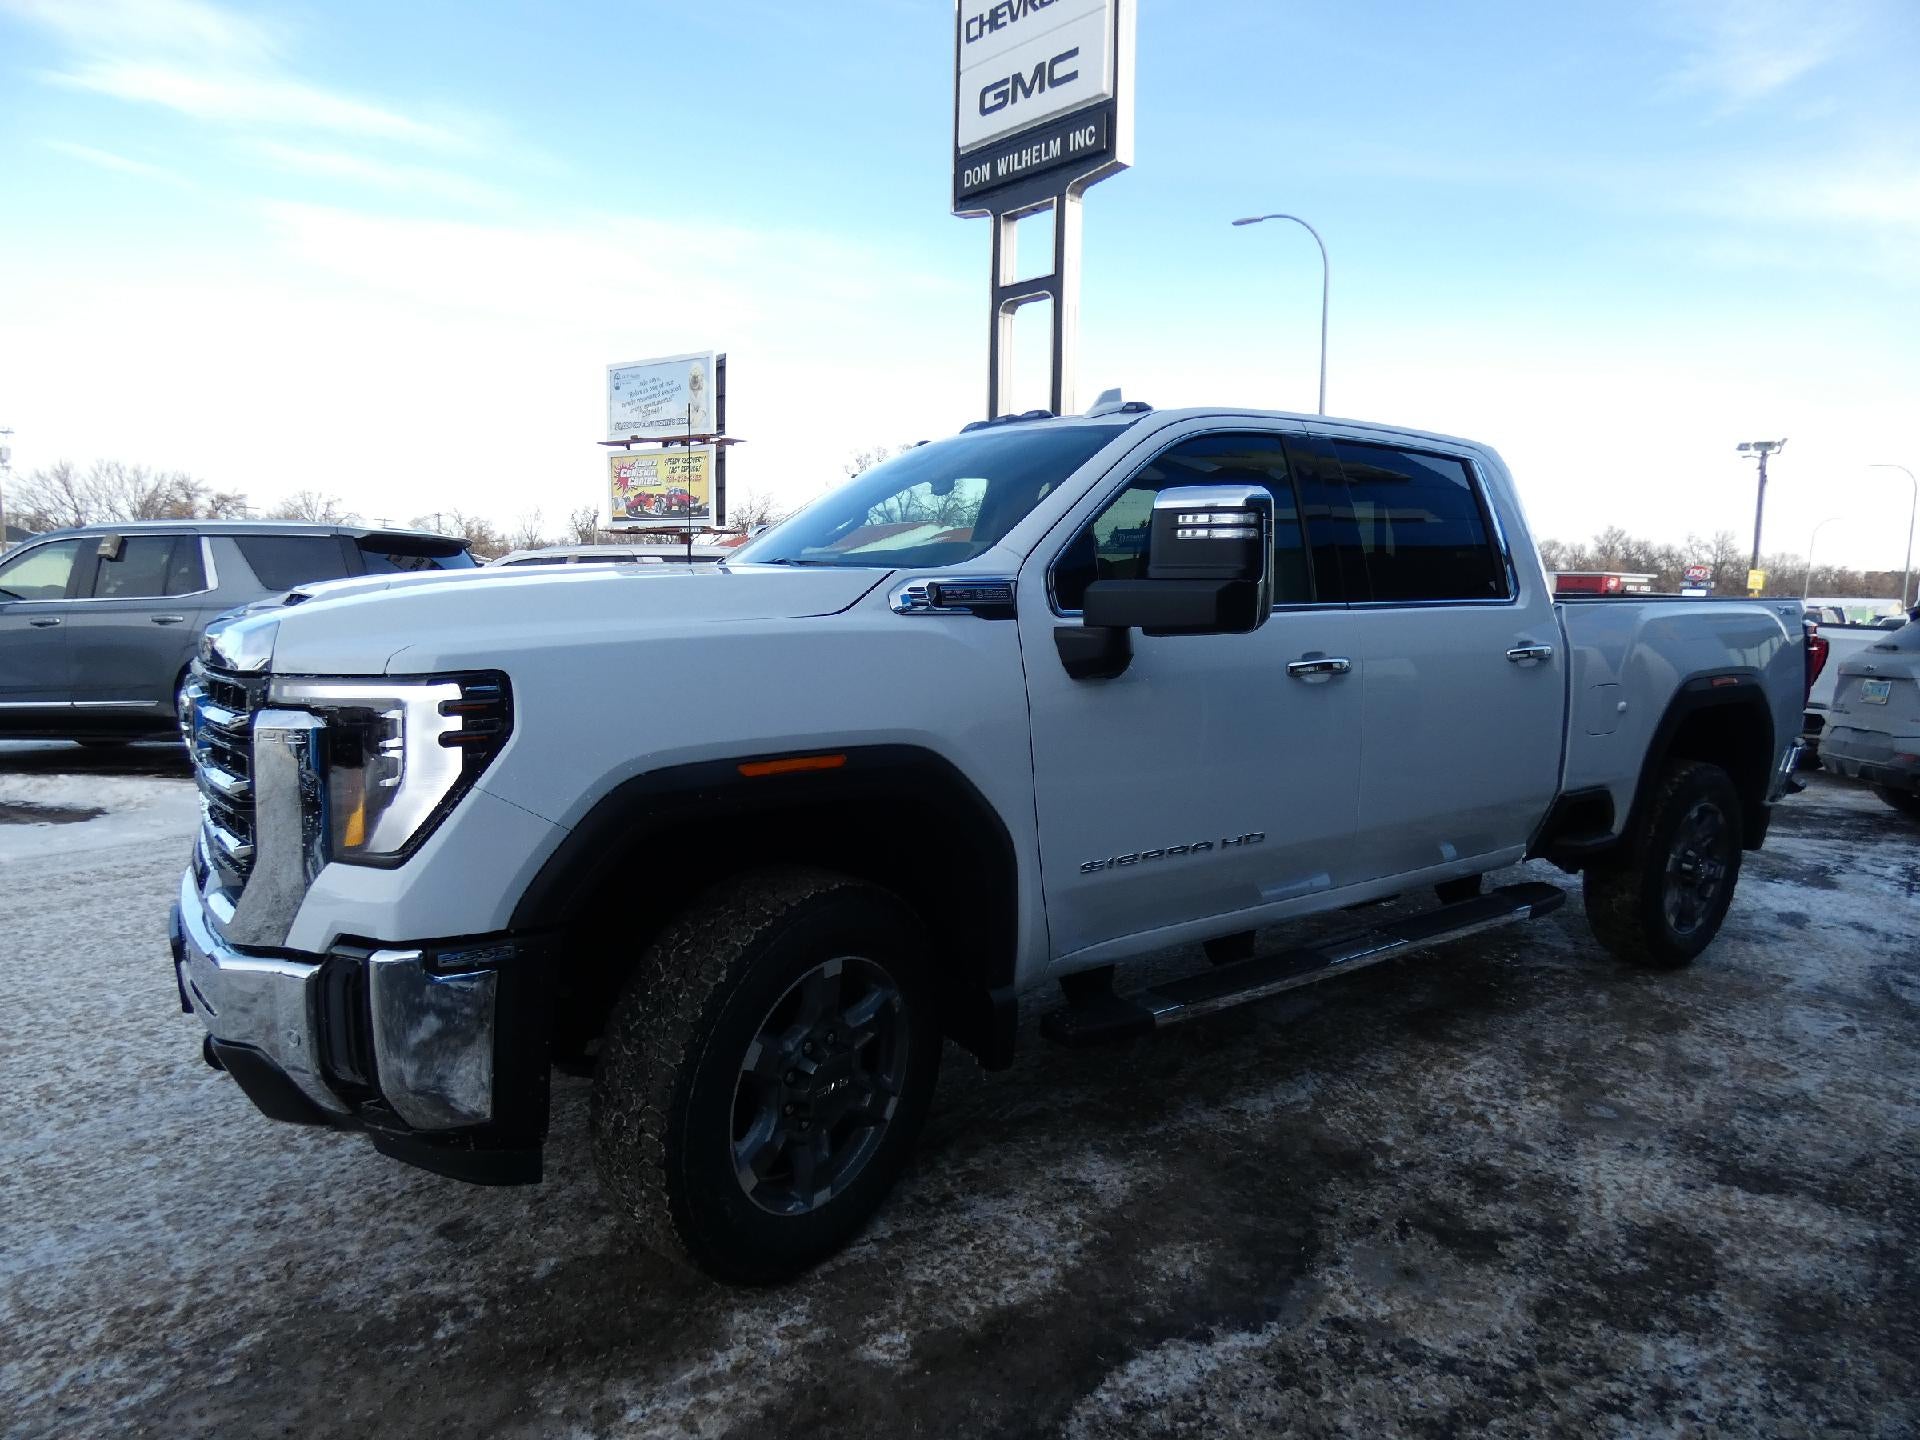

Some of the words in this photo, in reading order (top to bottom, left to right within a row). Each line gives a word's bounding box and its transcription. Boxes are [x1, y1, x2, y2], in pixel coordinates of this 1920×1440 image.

[966, 0, 1059, 44] CHEVR
[979, 47, 1079, 116] GMC
[964, 163, 990, 188] DON
[997, 138, 1061, 177] WILHELM
[1069, 126, 1096, 152] INC
[1080, 841, 1214, 874] SIERRA
[1221, 832, 1266, 849] HD
